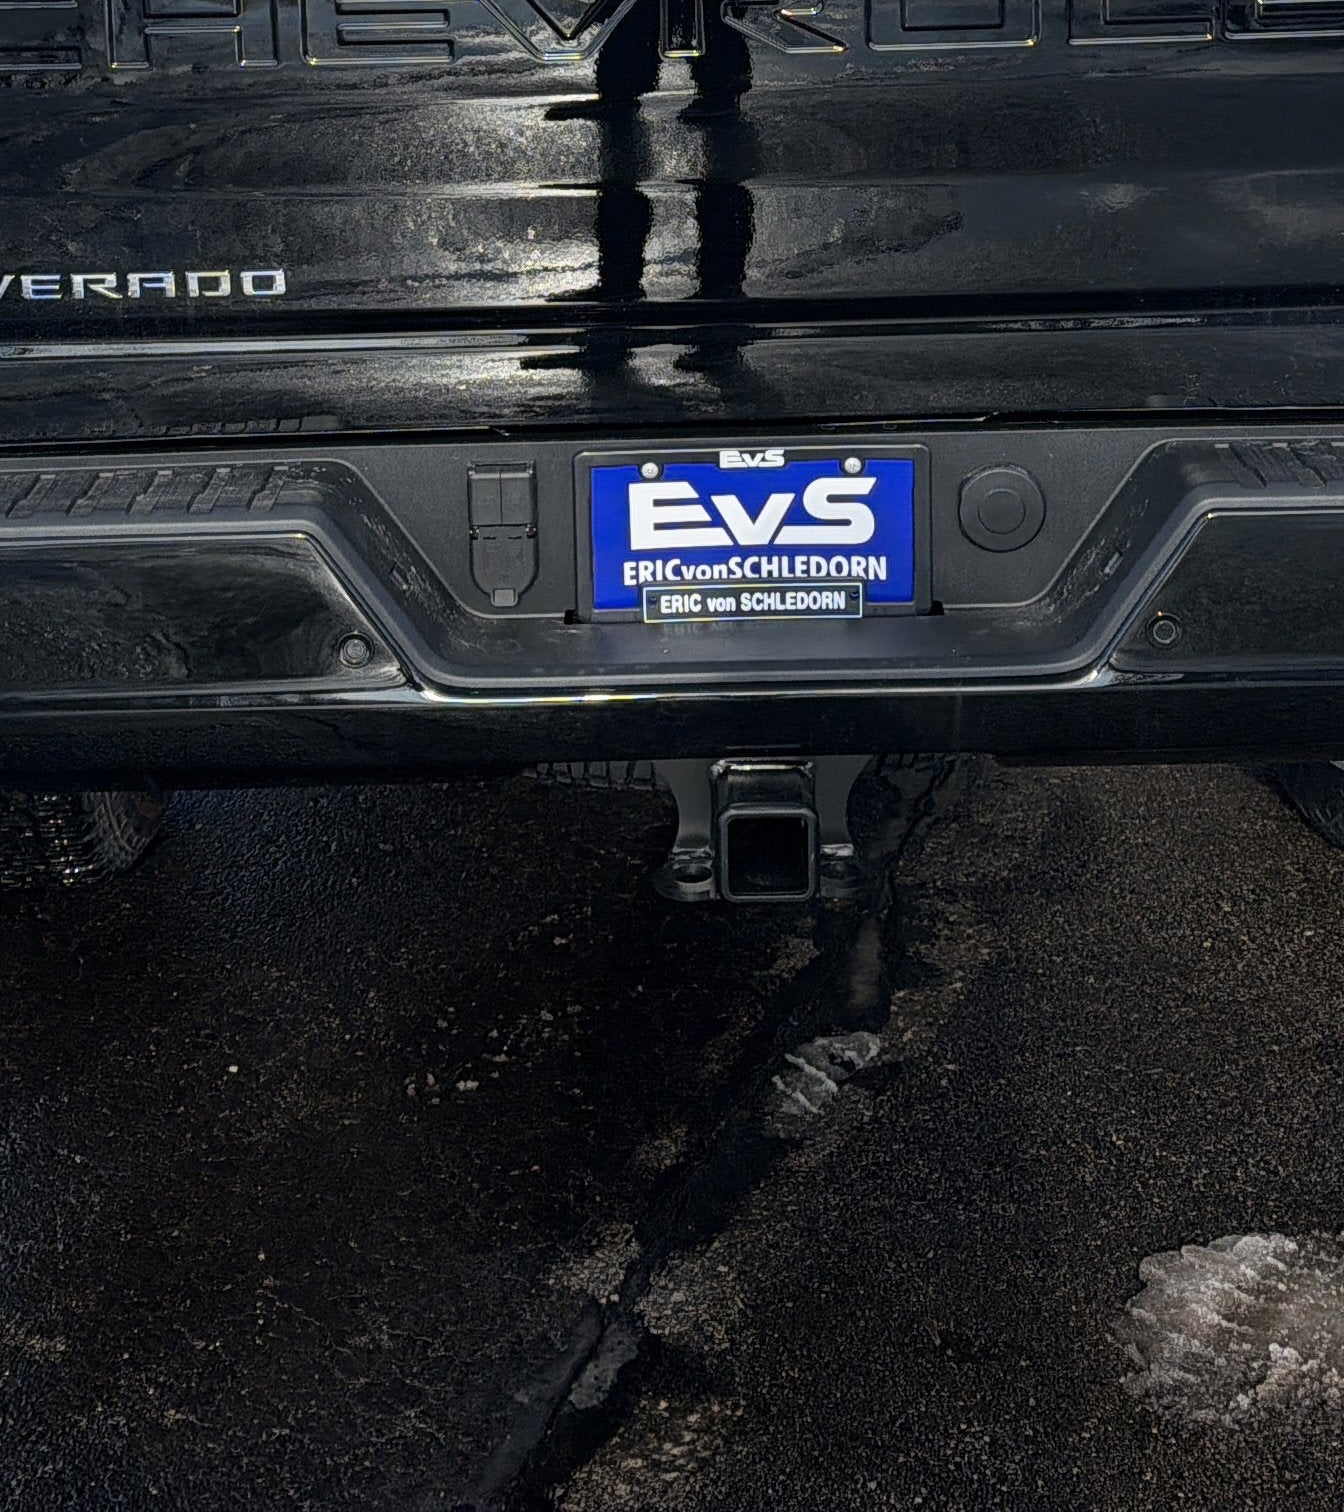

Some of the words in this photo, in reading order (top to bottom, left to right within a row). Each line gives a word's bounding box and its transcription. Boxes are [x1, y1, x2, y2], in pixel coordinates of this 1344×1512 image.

[660, 594, 702, 614] ERIC
[707, 597, 736, 612] von
[740, 591, 846, 612] SCHLEDORN
